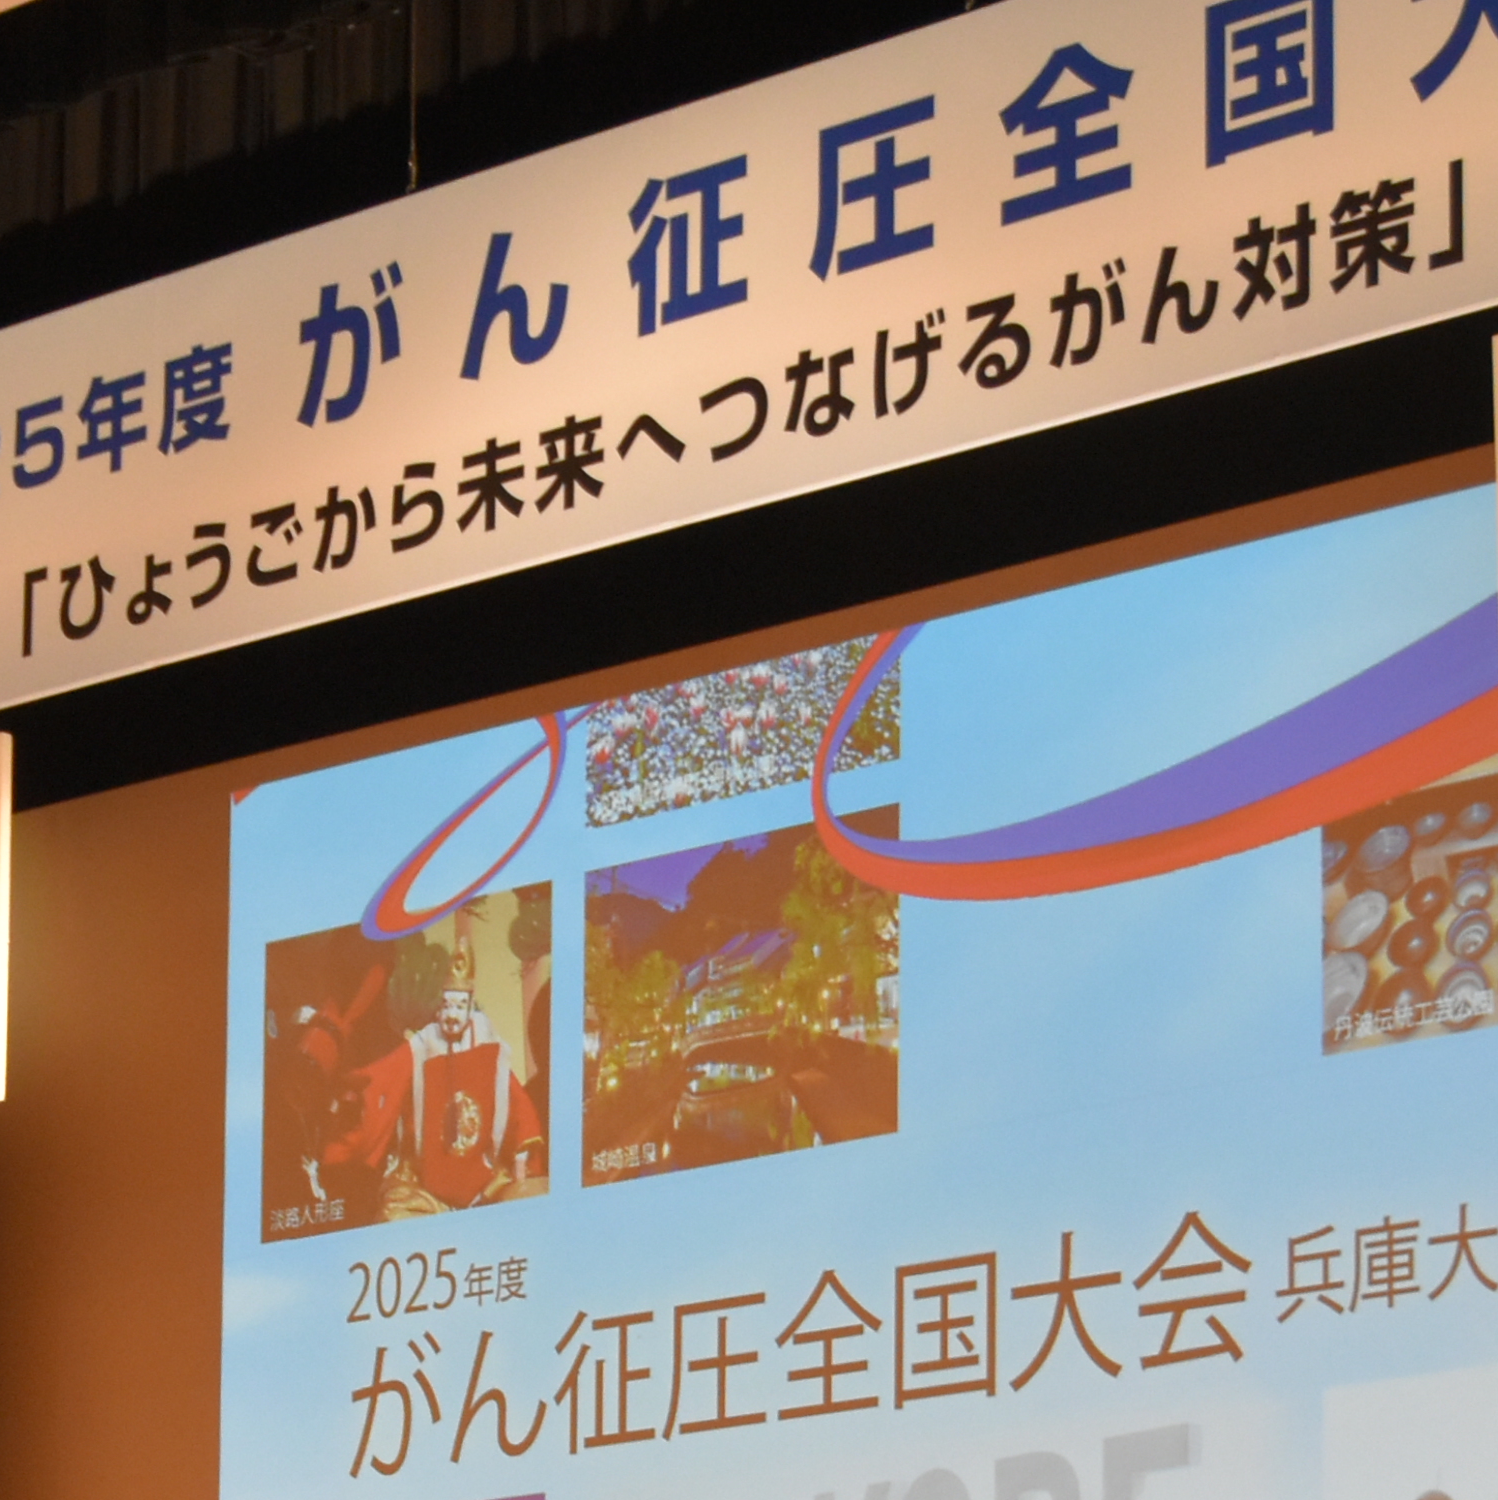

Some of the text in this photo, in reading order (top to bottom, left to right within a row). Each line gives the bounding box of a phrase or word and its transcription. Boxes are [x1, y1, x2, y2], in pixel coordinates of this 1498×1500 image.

[21, 157, 1464, 658] 「ひょうごから未来へつなげるがん対策」
[347, 1247, 529, 1324] 2025年度
[347, 1209, 1253, 1481] がん征圧全国大会
